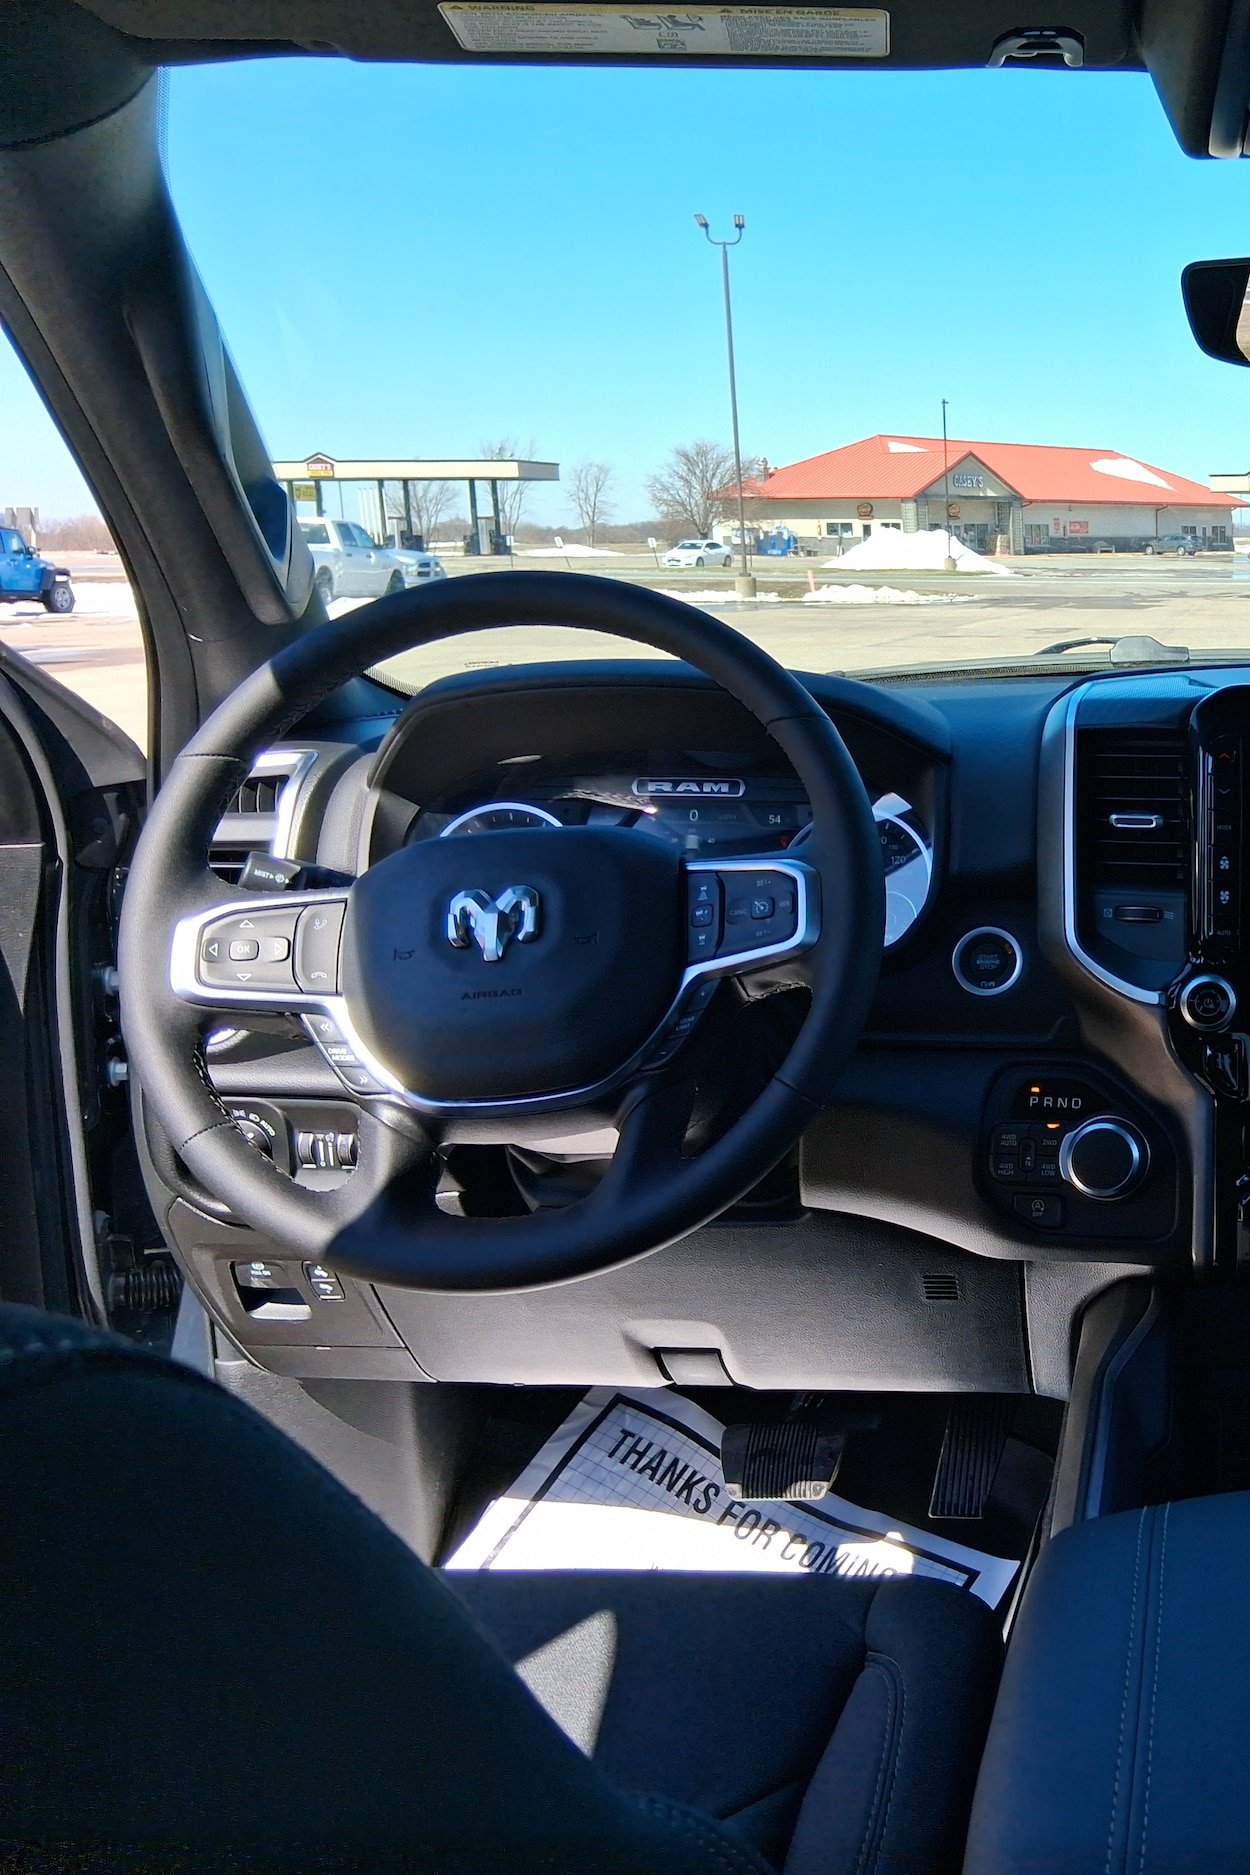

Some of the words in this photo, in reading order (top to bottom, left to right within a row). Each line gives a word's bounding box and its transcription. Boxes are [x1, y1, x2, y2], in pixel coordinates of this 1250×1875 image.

[467, 4, 535, 12] WARNING
[953, 474, 984, 488] CASEY'S
[647, 781, 730, 793] RAM
[689, 809, 699, 822] 0
[768, 814, 781, 824] 54
[890, 855, 907, 865] 120
[254, 869, 270, 879] MIST
[237, 945, 251, 954] OK
[461, 988, 523, 1001] AIRBAG
[260, 1120, 276, 1137] AUTO
[607, 1428, 720, 1514] THANKS
[716, 1500, 781, 1550] FOR
